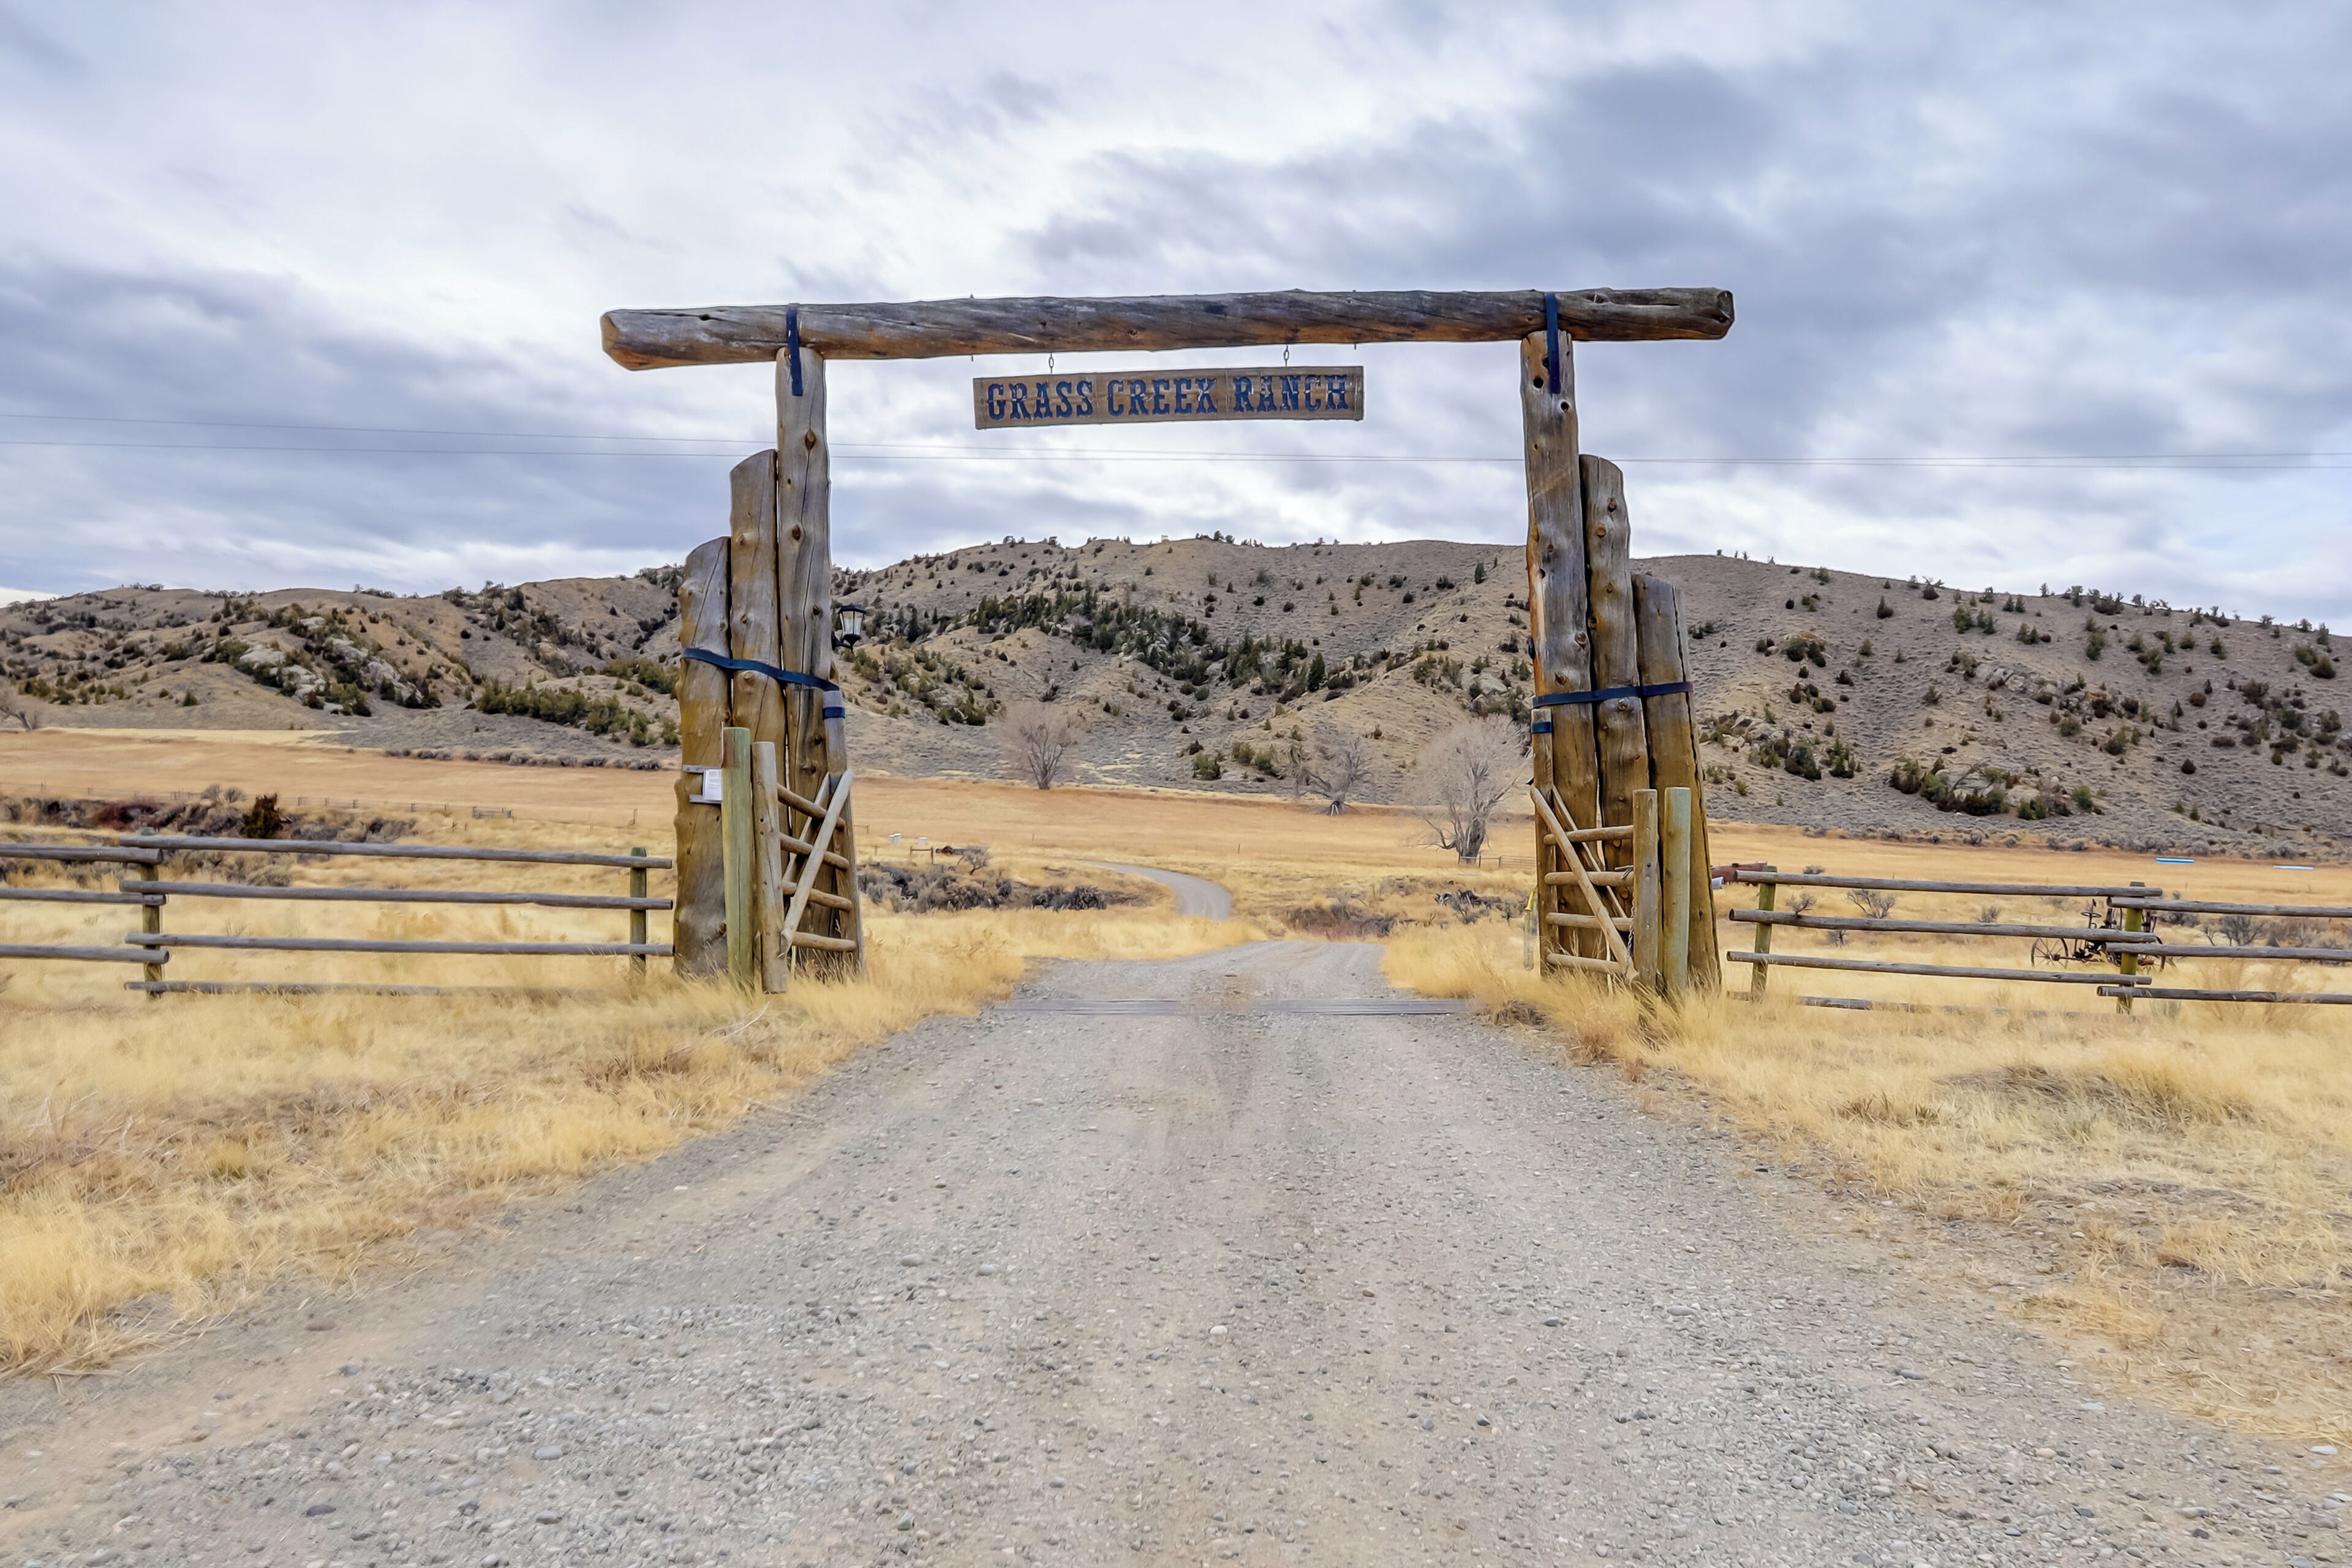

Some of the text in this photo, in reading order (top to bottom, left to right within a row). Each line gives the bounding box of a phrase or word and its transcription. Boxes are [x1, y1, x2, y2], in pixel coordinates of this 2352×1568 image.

[987, 374, 1349, 420] GRASS CREEK RANCH
